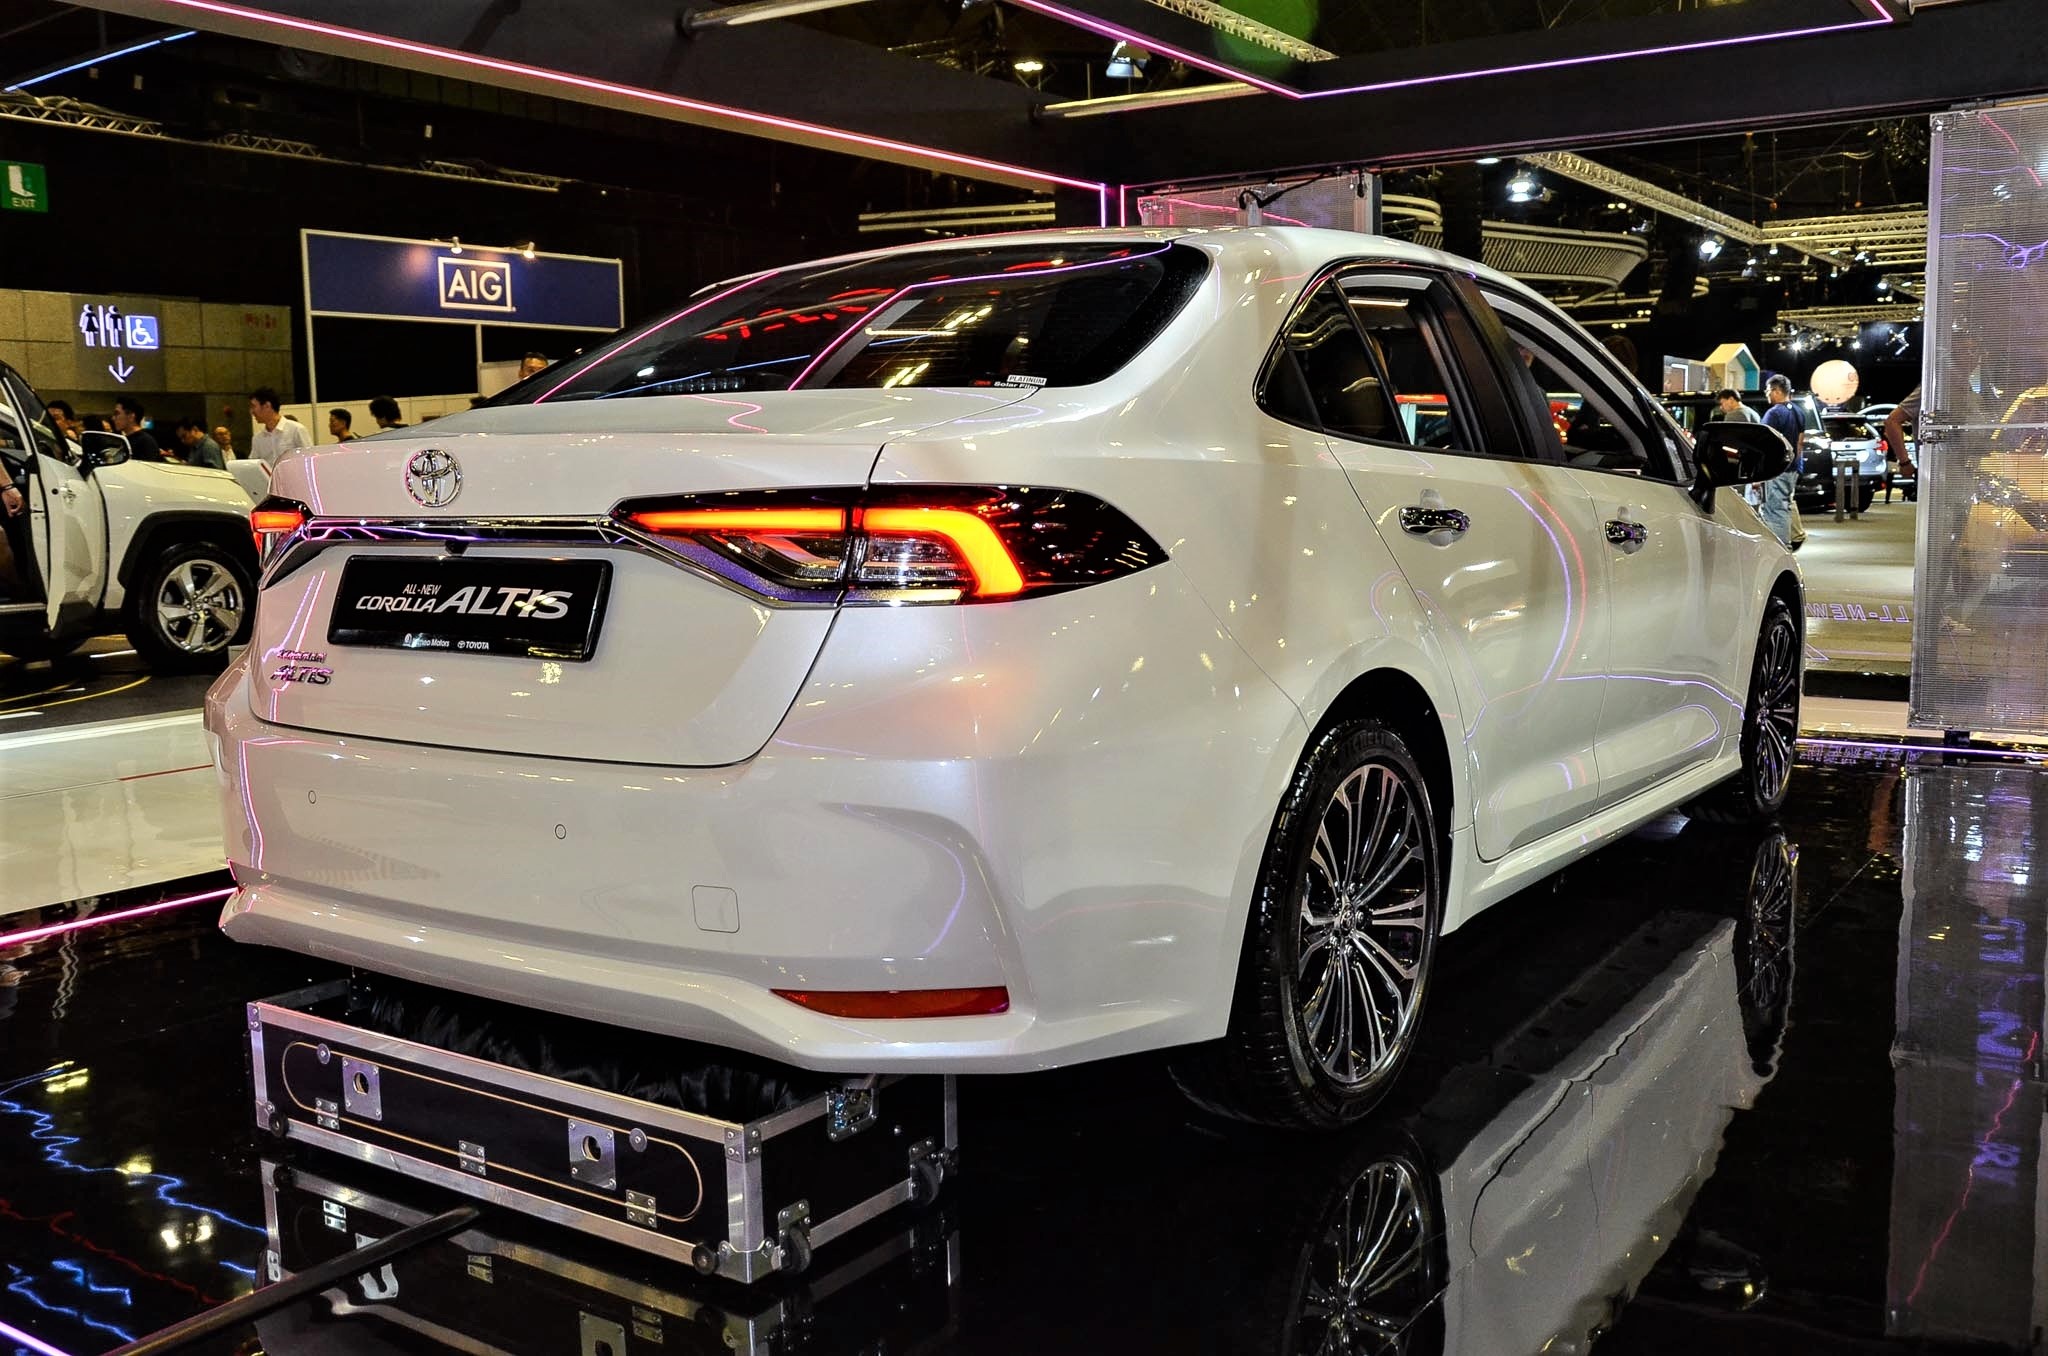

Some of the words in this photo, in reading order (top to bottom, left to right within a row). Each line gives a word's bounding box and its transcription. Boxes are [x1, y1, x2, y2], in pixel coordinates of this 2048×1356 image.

[447, 268, 503, 301] AIG
[402, 583, 442, 595] ALL-NEW
[355, 596, 437, 613] COROLLA
[433, 586, 573, 620] ALTIS
[430, 638, 450, 648] Motors
[466, 641, 490, 650] TOYOTA
